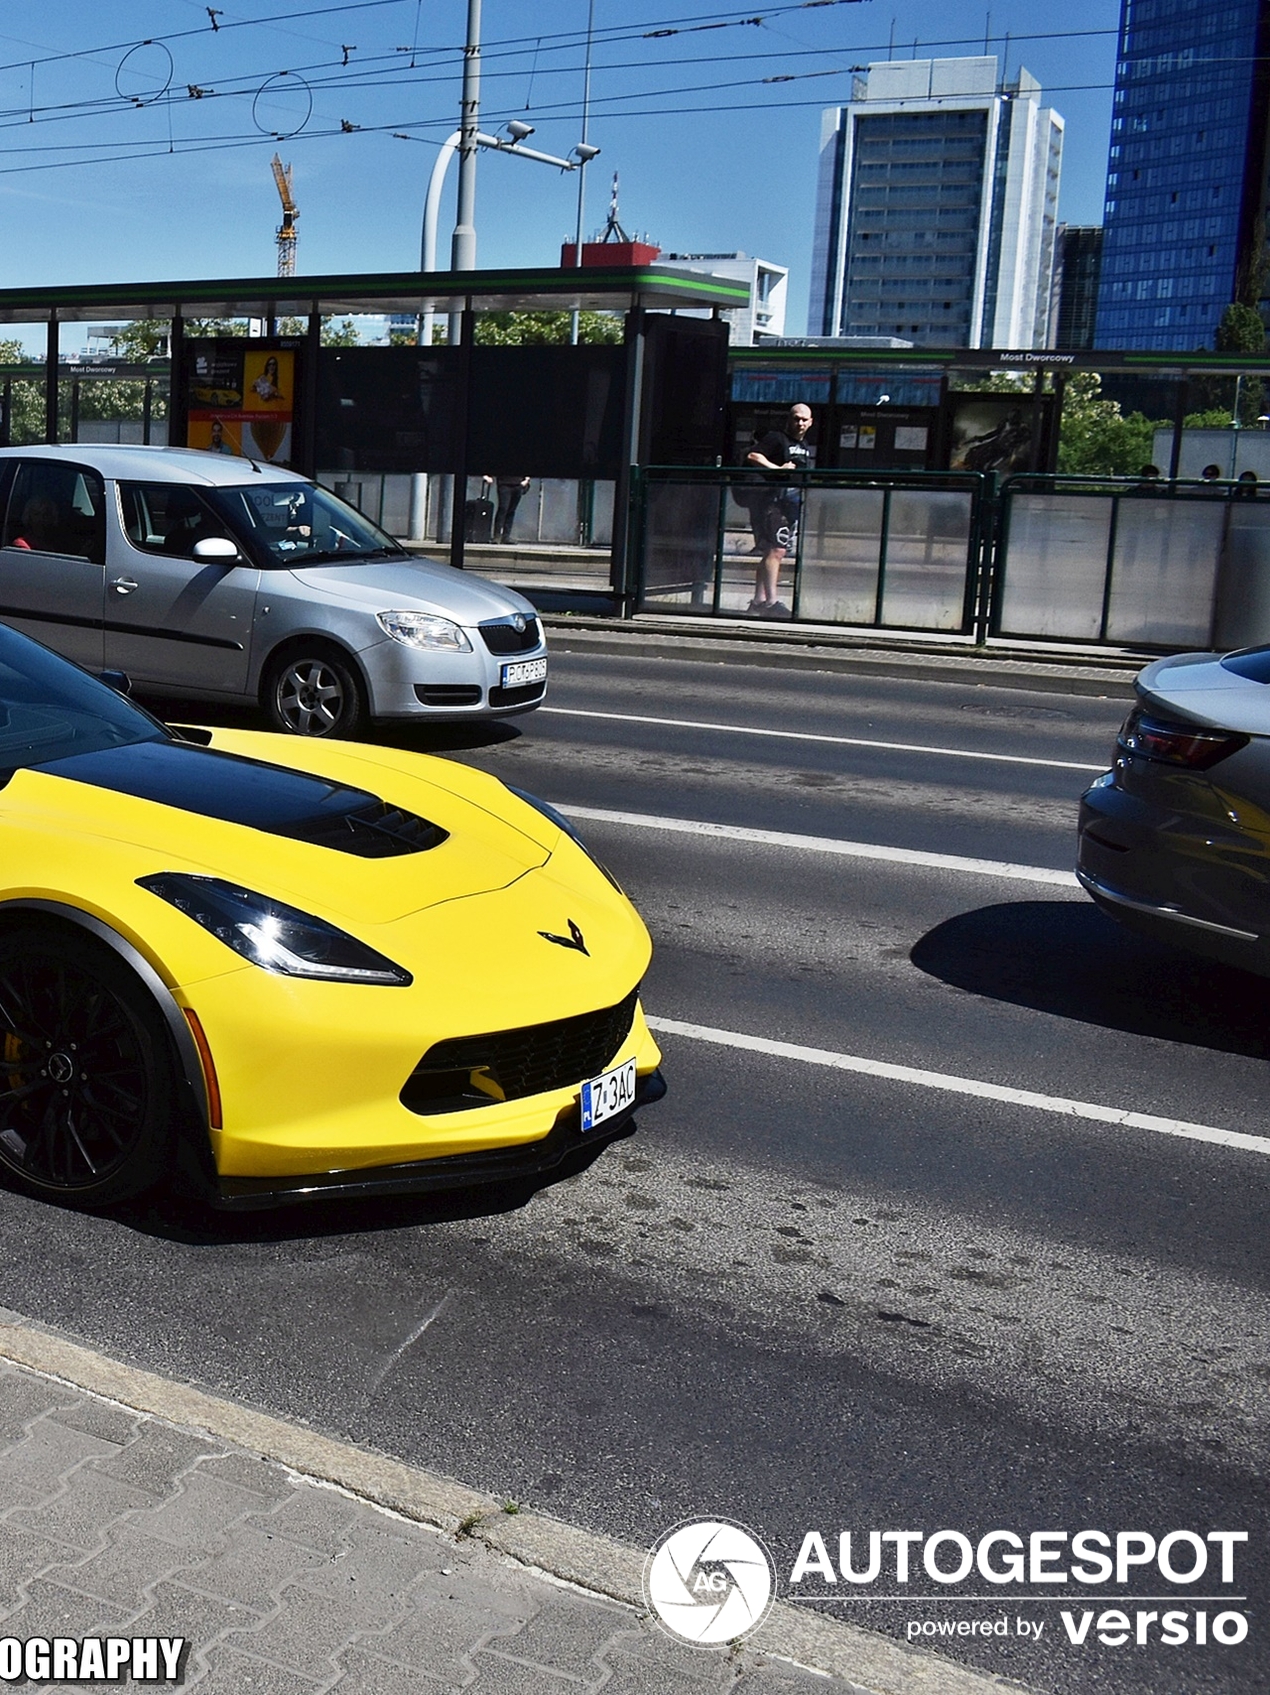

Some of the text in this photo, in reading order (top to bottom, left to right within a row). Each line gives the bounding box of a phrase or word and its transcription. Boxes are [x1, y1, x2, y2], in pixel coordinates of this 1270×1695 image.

[1000, 353, 1075, 364] Most Dworcowy
[593, 1065, 634, 1121] Z 3AC
